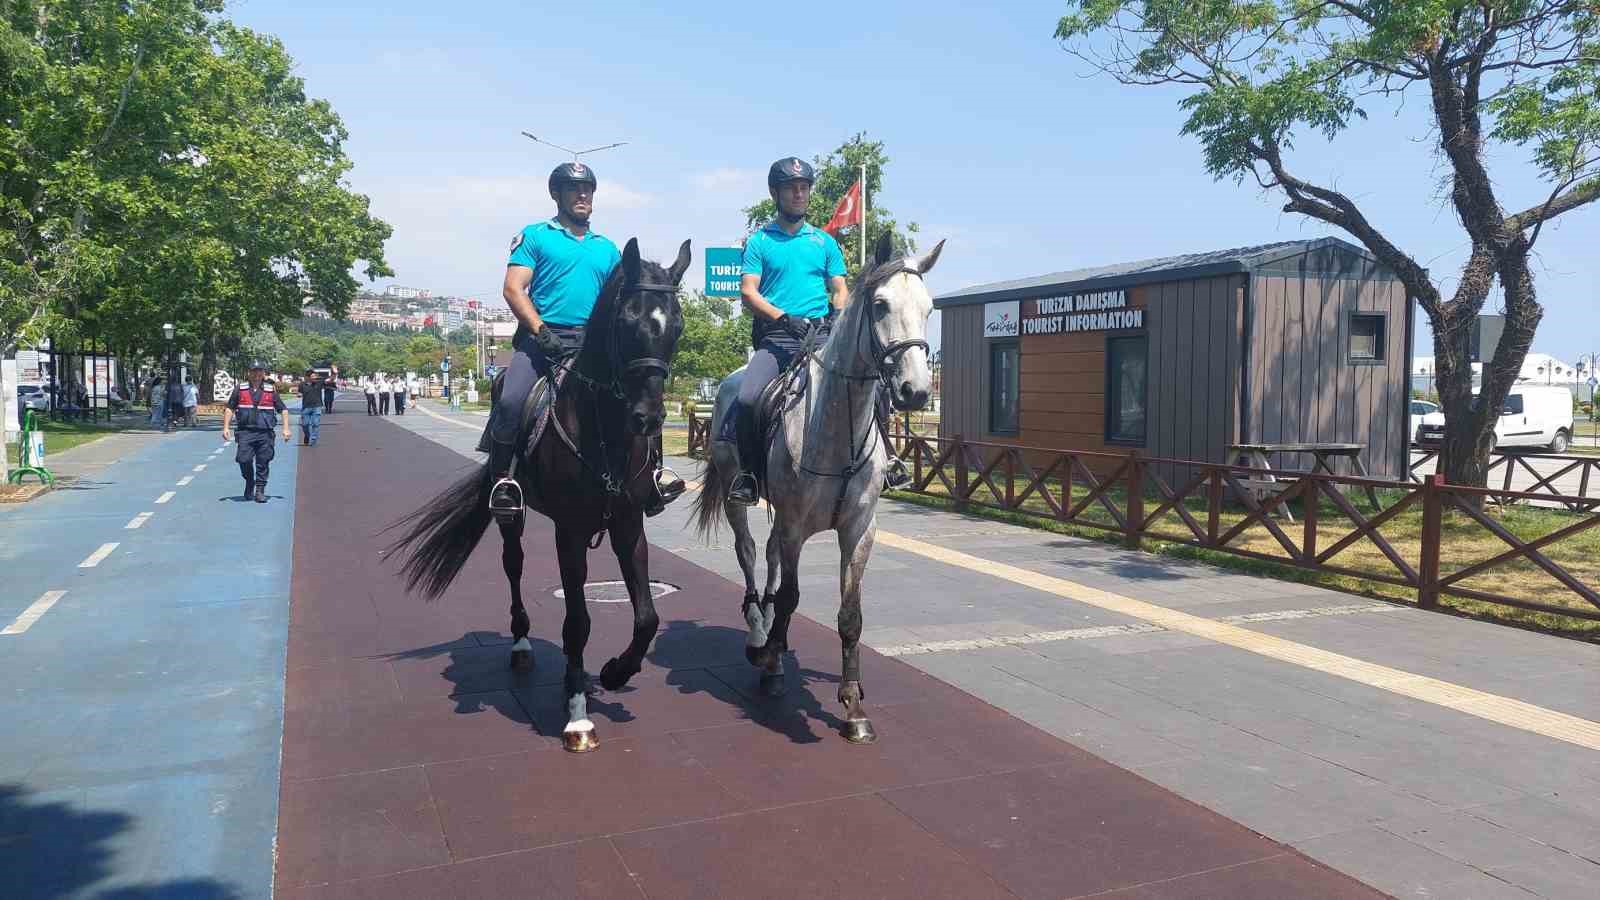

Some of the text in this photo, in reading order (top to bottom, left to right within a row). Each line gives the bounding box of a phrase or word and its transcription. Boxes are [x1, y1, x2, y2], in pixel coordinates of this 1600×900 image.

[710, 262, 742, 276] TURİZ
[710, 280, 741, 291] TOURIS
[1076, 290, 1126, 311] DANIŞMA
[1022, 316, 1064, 334] TOURIST
[1065, 310, 1142, 332] INFORMATION
